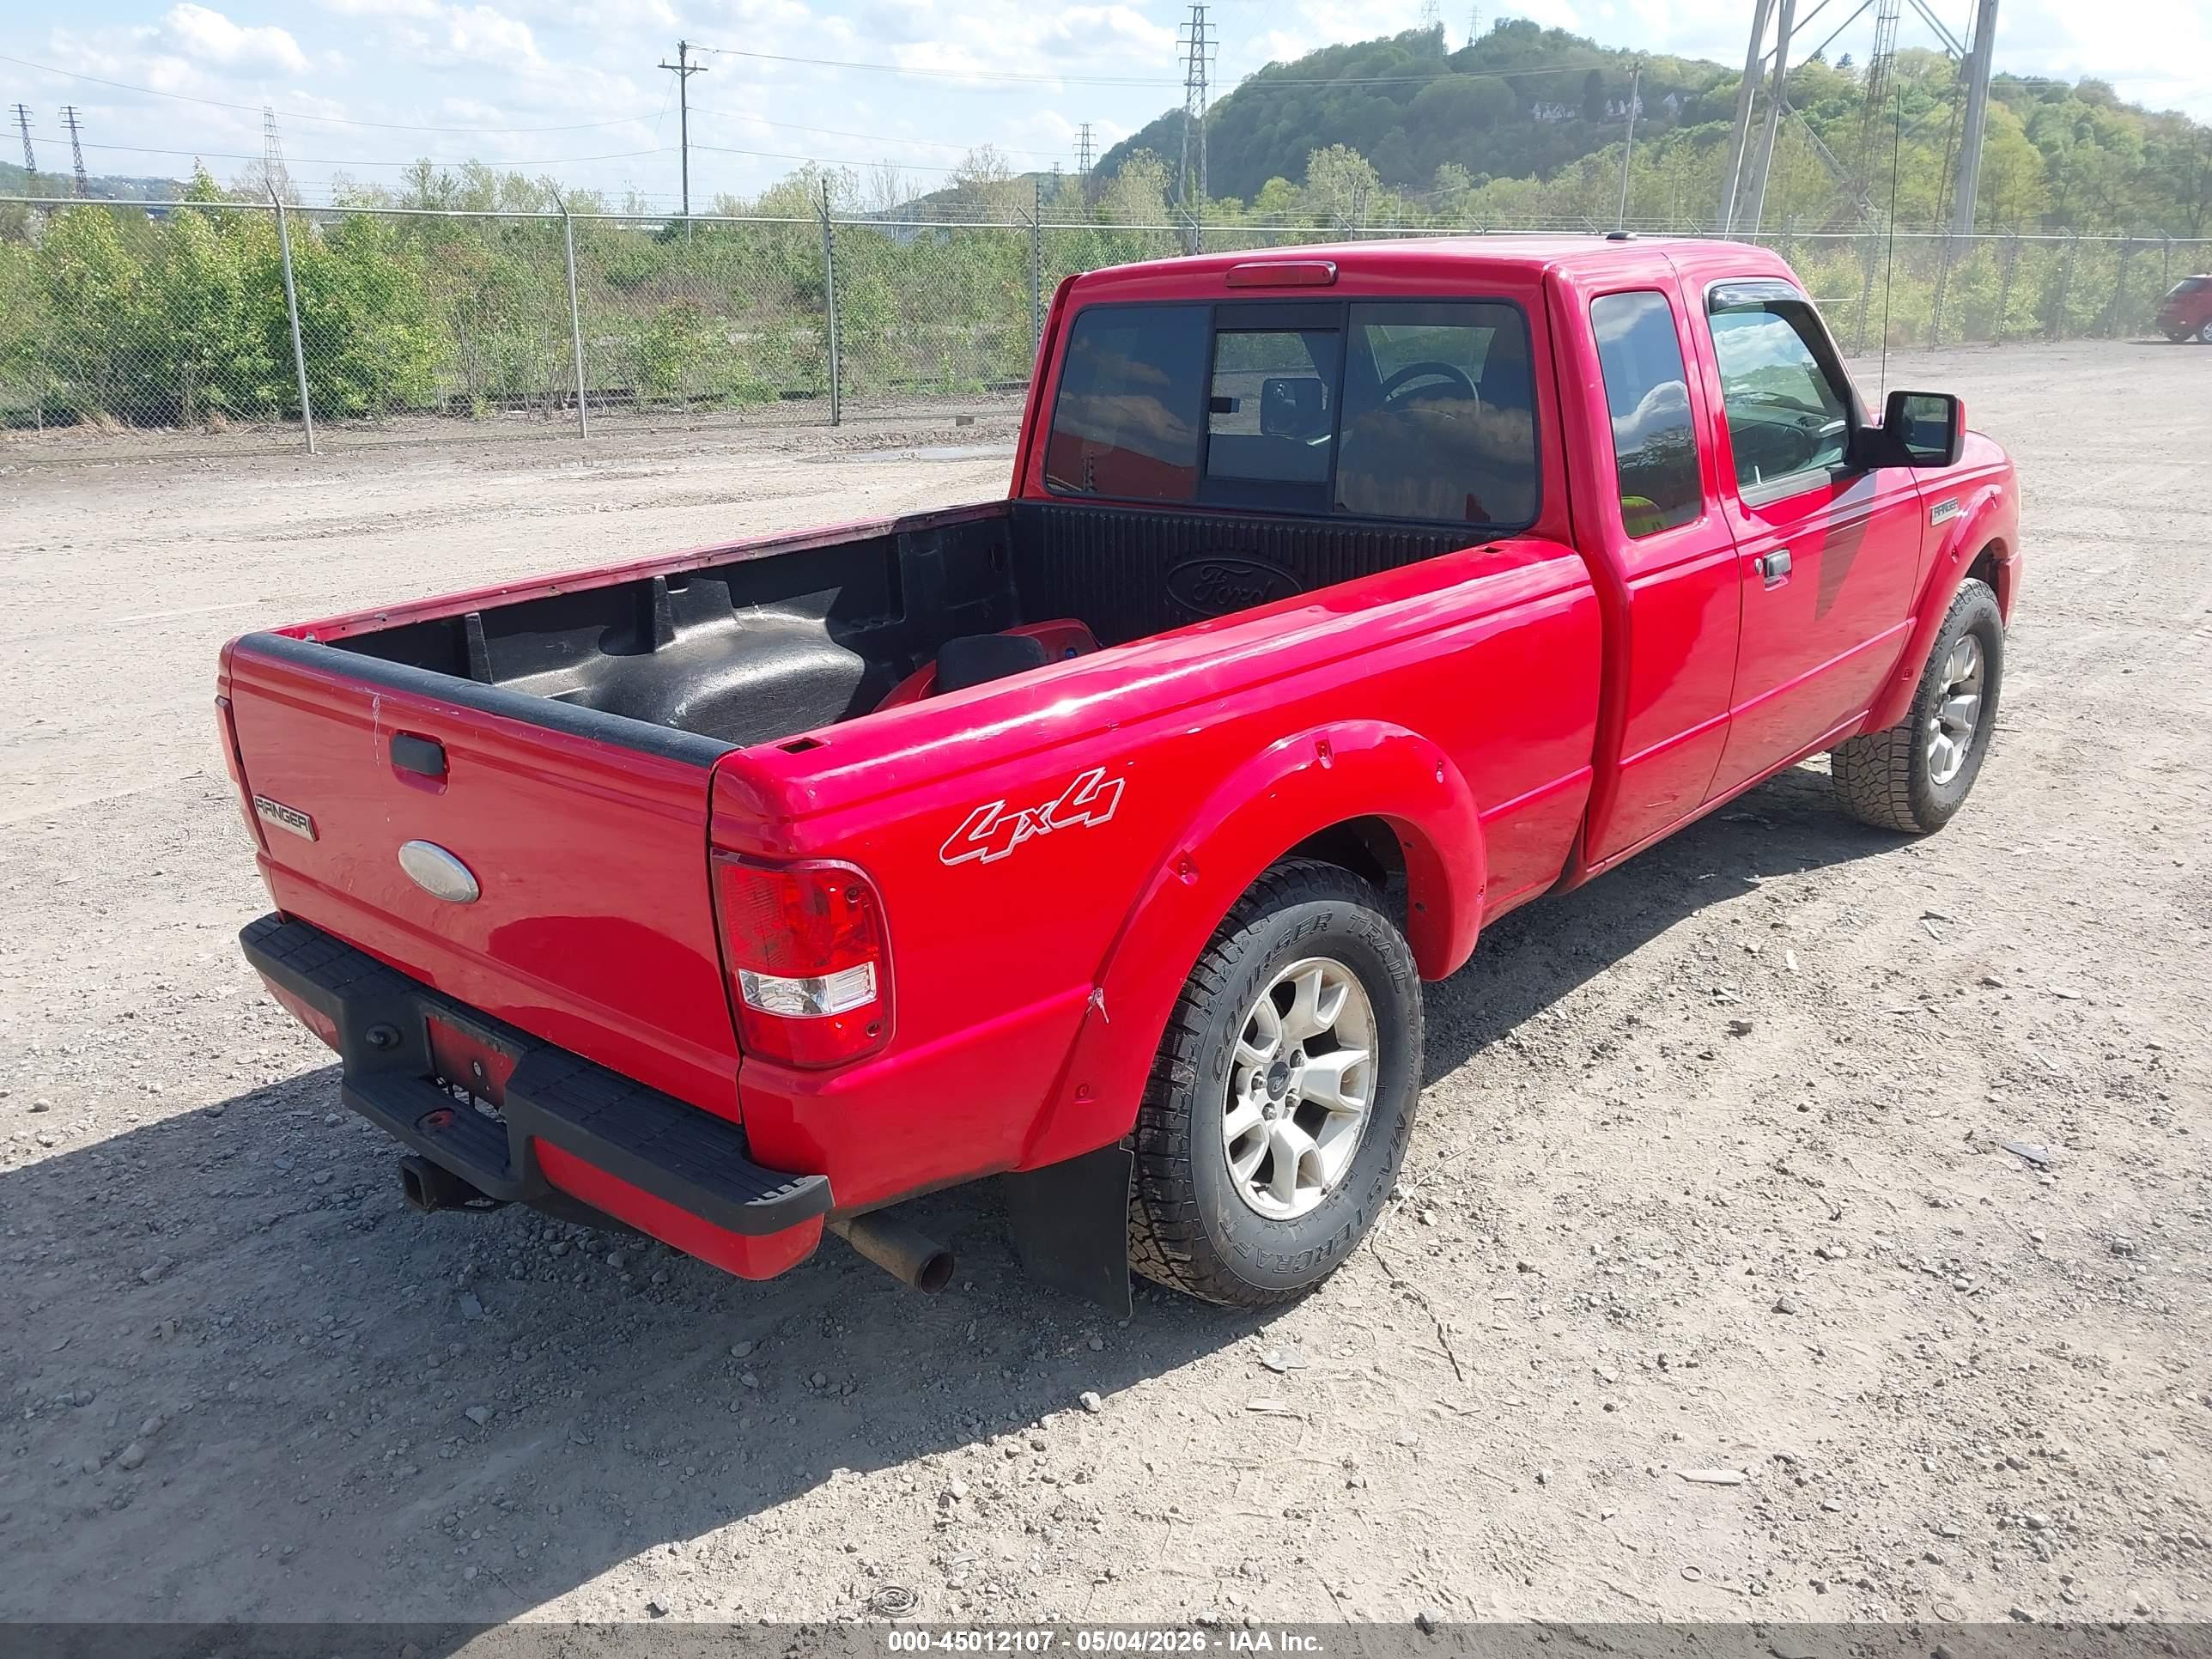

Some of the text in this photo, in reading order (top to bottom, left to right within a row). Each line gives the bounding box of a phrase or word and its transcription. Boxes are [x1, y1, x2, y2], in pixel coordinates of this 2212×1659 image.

[1194, 563, 1273, 605] Ford
[253, 797, 311, 833] RANGER
[939, 765, 1126, 866] 4x4
[1346, 912, 1409, 994] TRAIL
[1218, 1111, 1407, 1274] MASTERCRAFT
